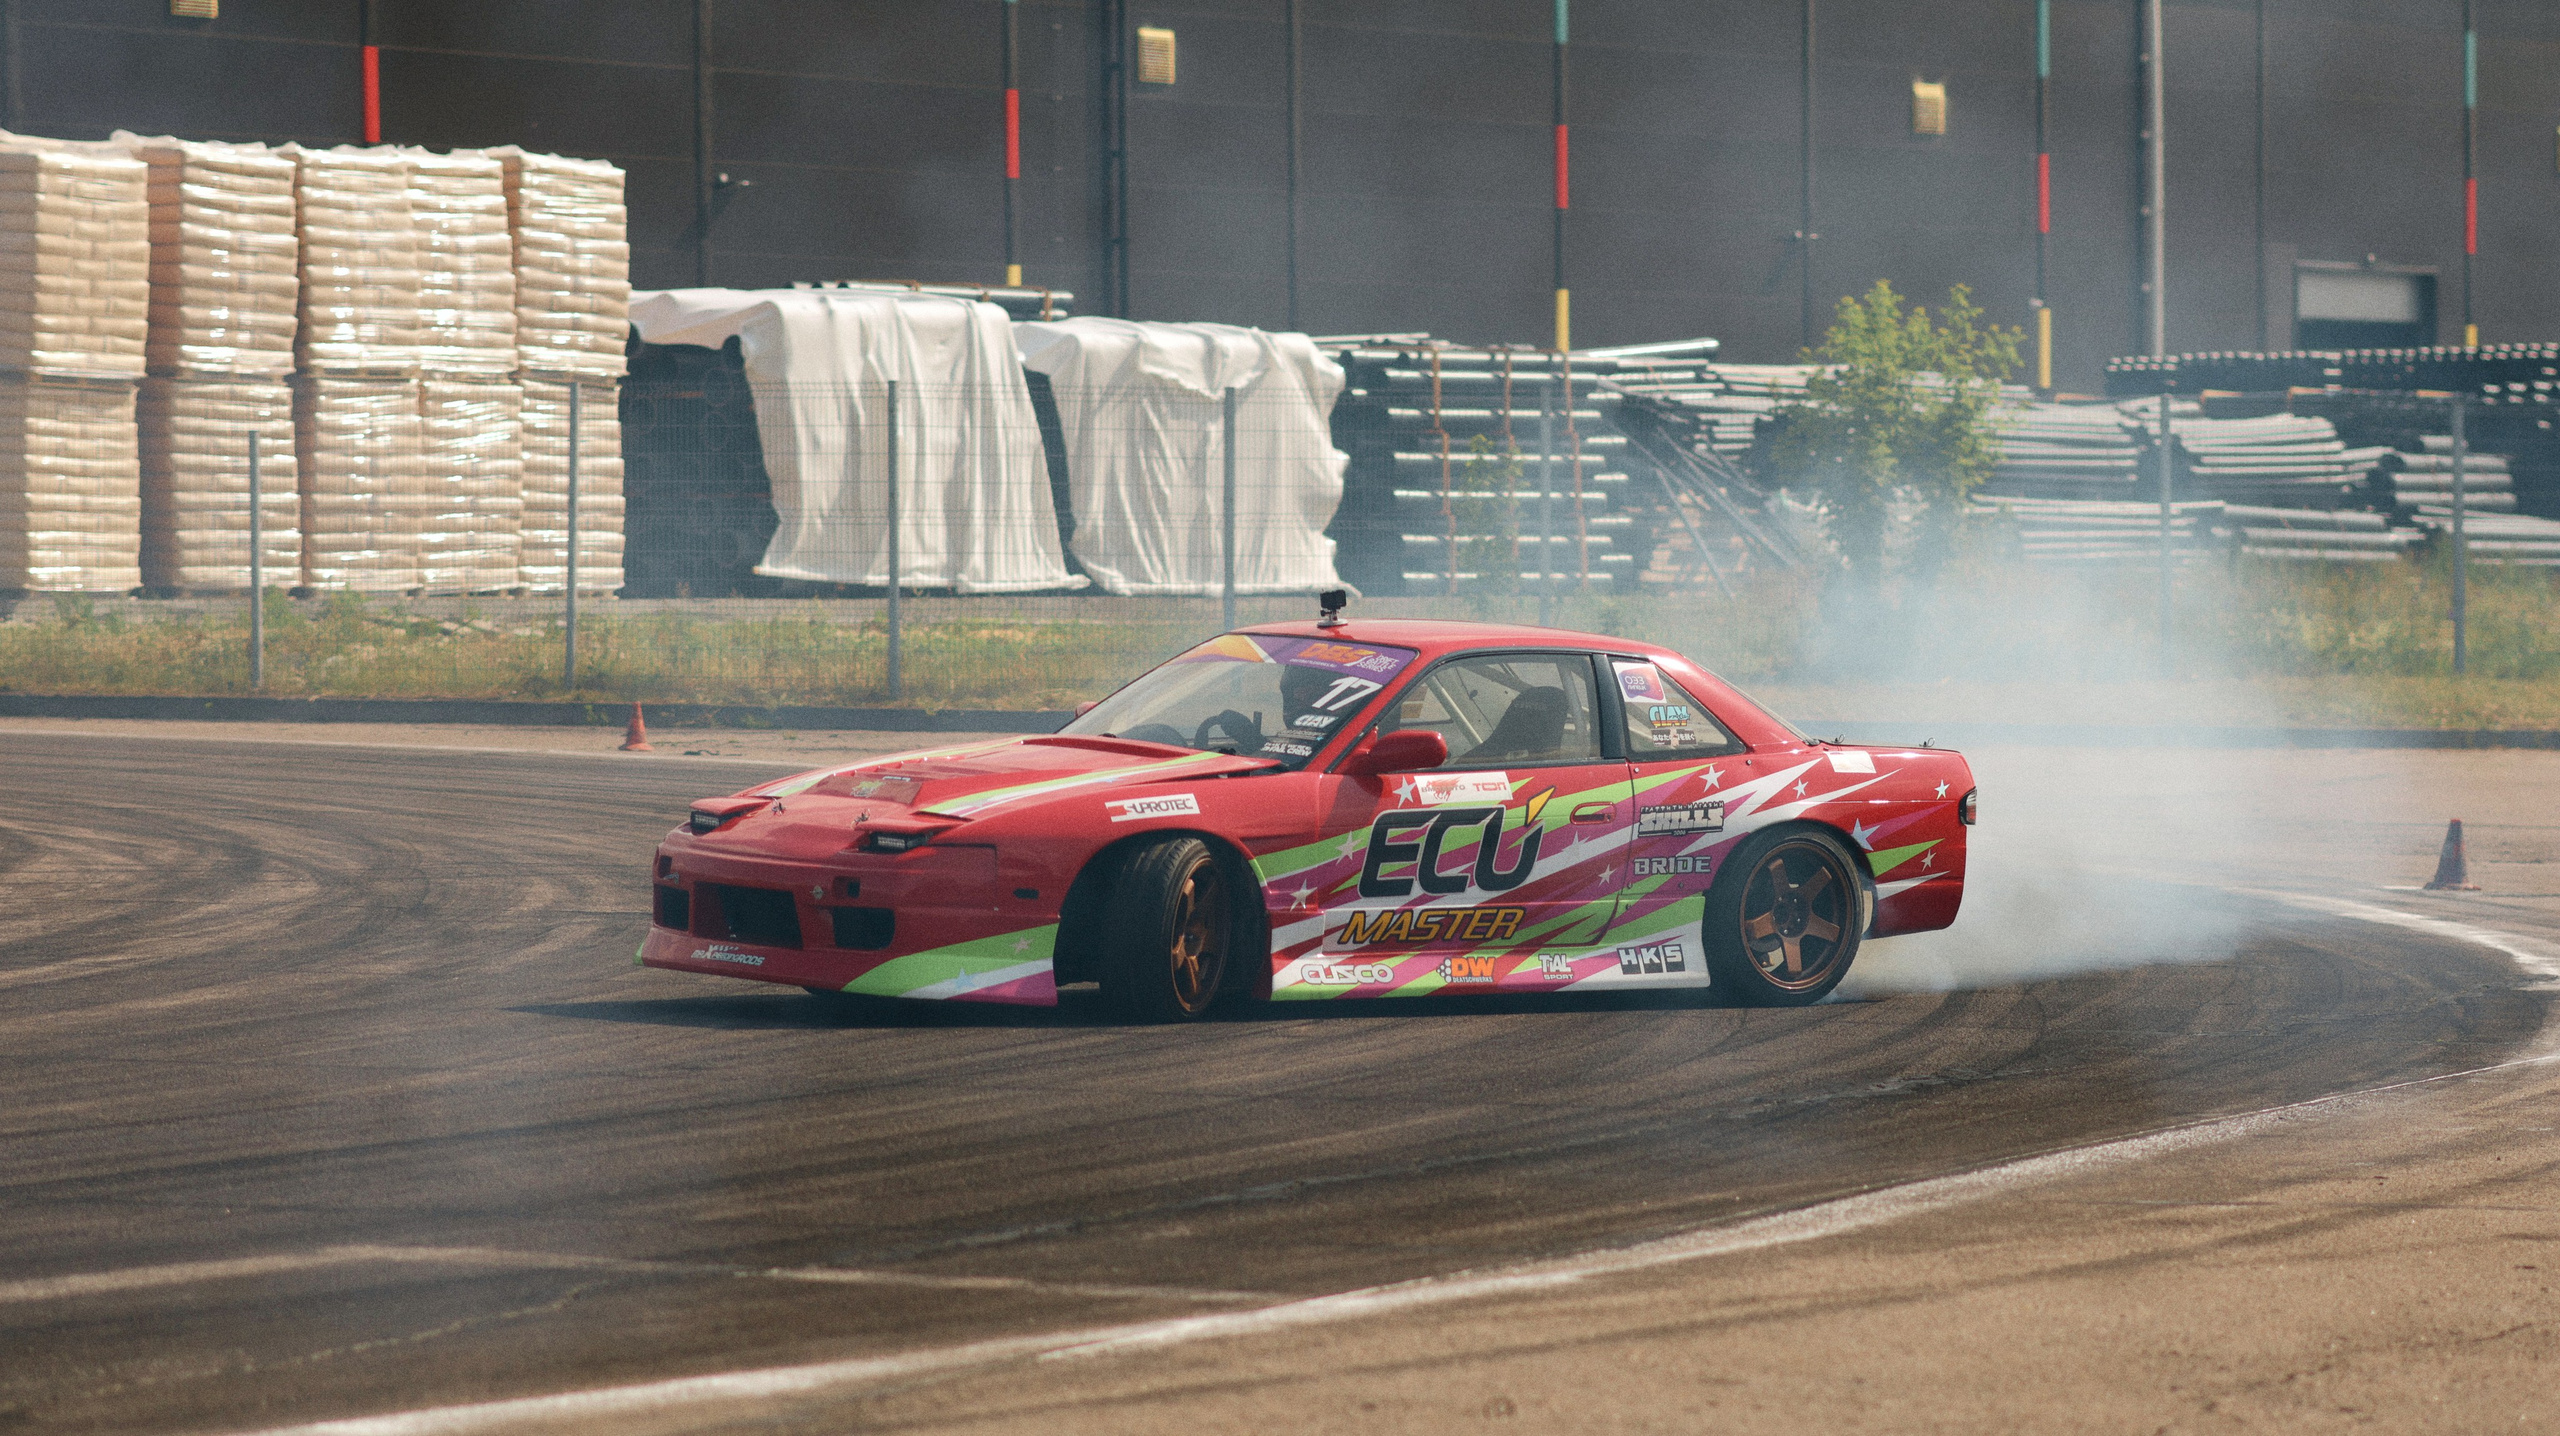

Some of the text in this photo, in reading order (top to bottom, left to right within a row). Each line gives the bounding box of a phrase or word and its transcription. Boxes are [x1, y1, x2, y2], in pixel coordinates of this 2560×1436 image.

[1311, 676, 1383, 711] 17
[1358, 804, 1546, 899] ECU
[1634, 856, 1711, 875] BRIDE
[1338, 906, 1527, 944] MASTER
[1618, 944, 1684, 967] HKS
[1301, 963, 1395, 985] CUSCO
[1450, 957, 1496, 977] DW
[1543, 972, 1575, 980] SPORT
